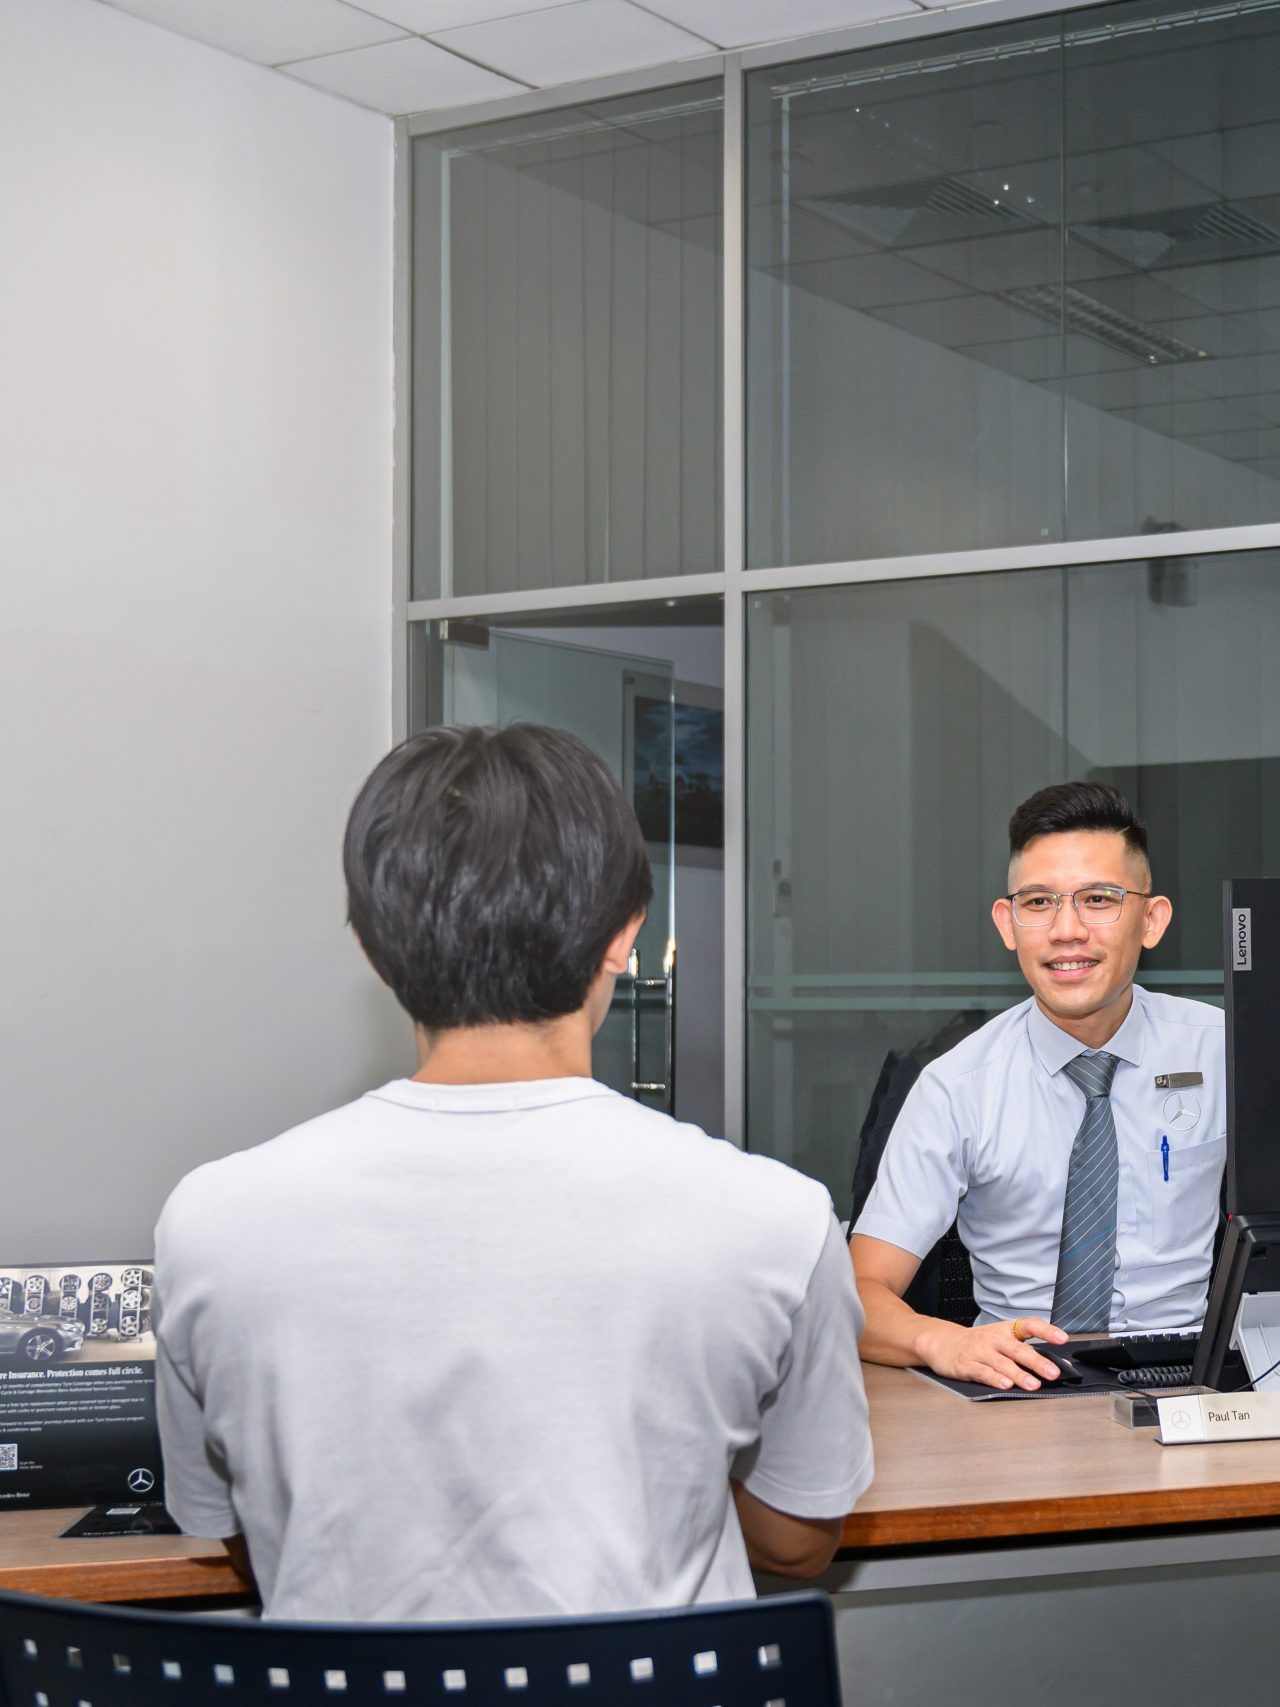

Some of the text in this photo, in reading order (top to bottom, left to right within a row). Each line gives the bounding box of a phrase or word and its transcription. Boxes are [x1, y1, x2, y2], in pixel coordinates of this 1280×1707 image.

[1237, 913, 1247, 966] Lenovo
[8, 1370, 46, 1380] Insurance.
[47, 1368, 84, 1378] Protection
[84, 1369, 108, 1377] comes
[108, 1366, 121, 1376] full
[121, 1366, 144, 1375] circle.
[1208, 1410, 1251, 1422] Paul Tan
